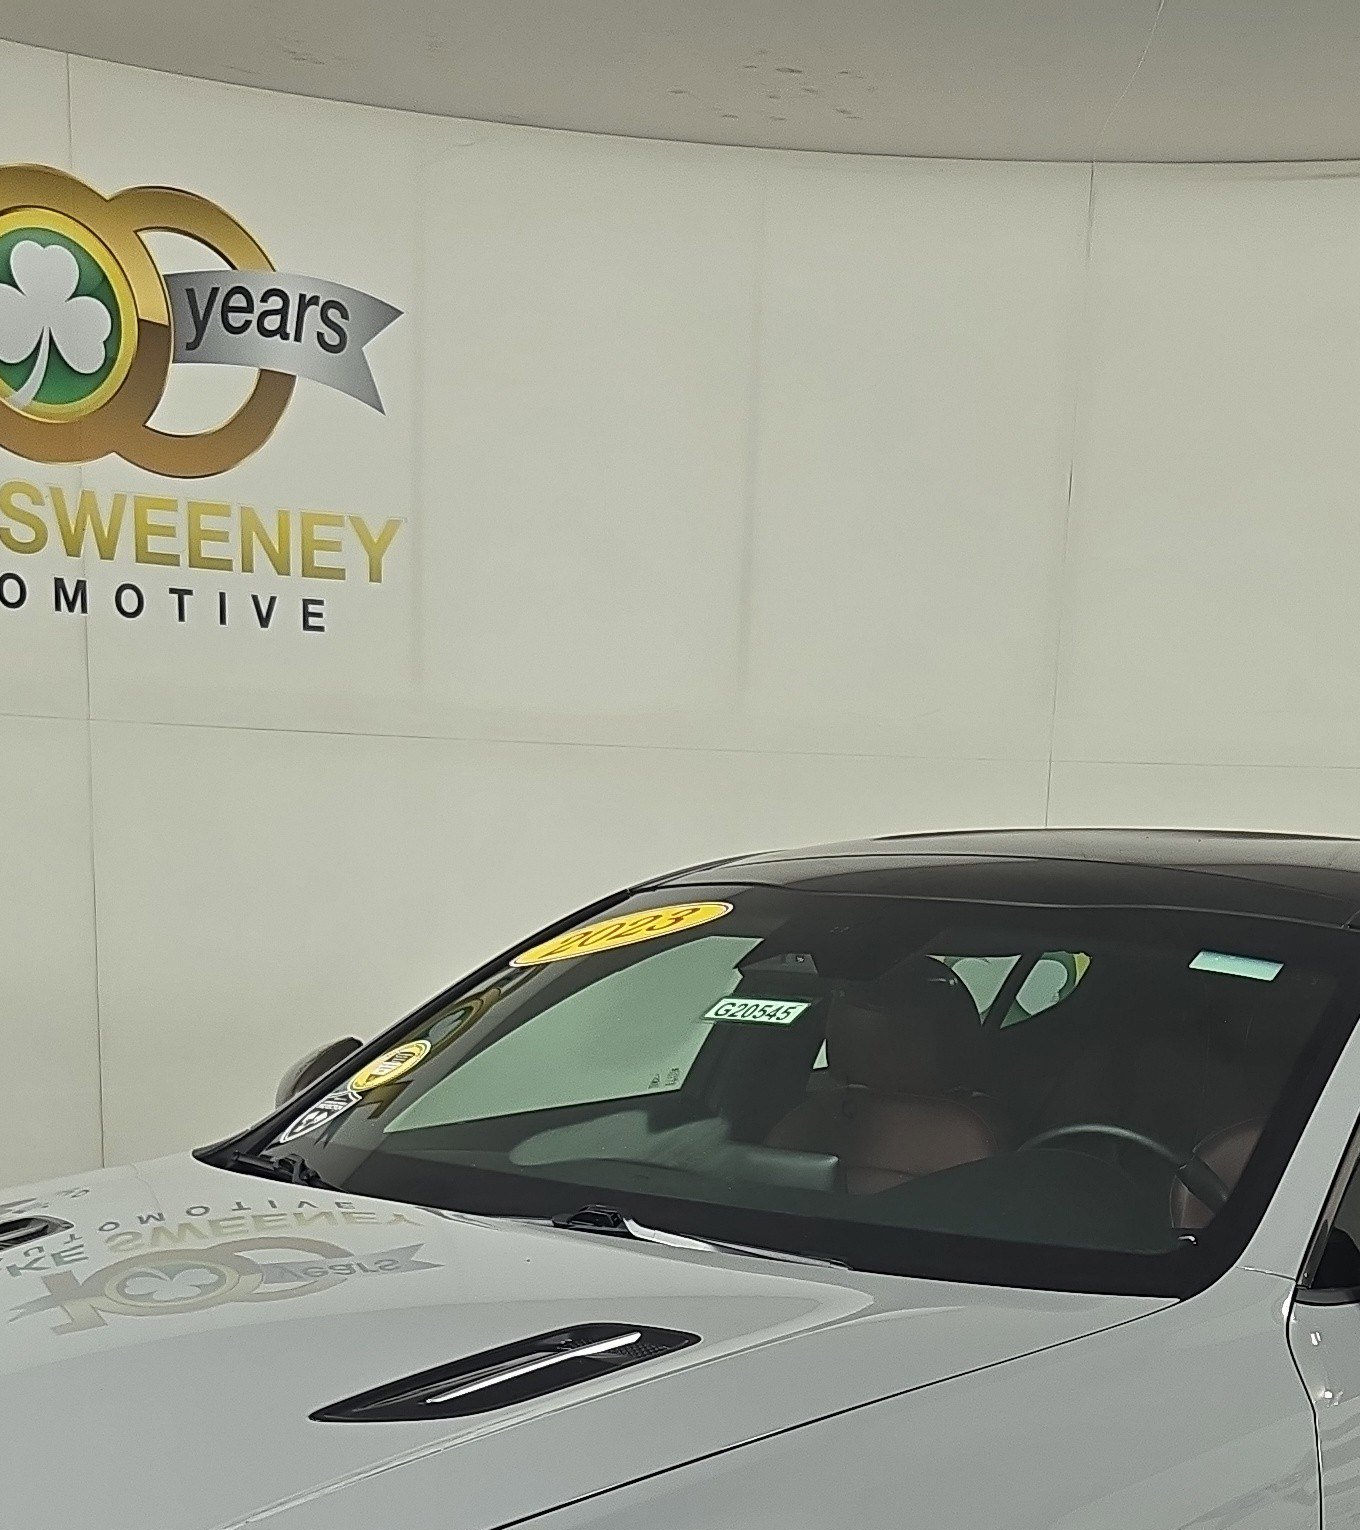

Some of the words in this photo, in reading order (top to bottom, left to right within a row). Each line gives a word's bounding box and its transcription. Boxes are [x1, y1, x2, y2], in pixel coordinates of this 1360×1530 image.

[184, 284, 351, 354] years
[536, 907, 701, 960] 2023
[713, 1001, 797, 1021] G20545
